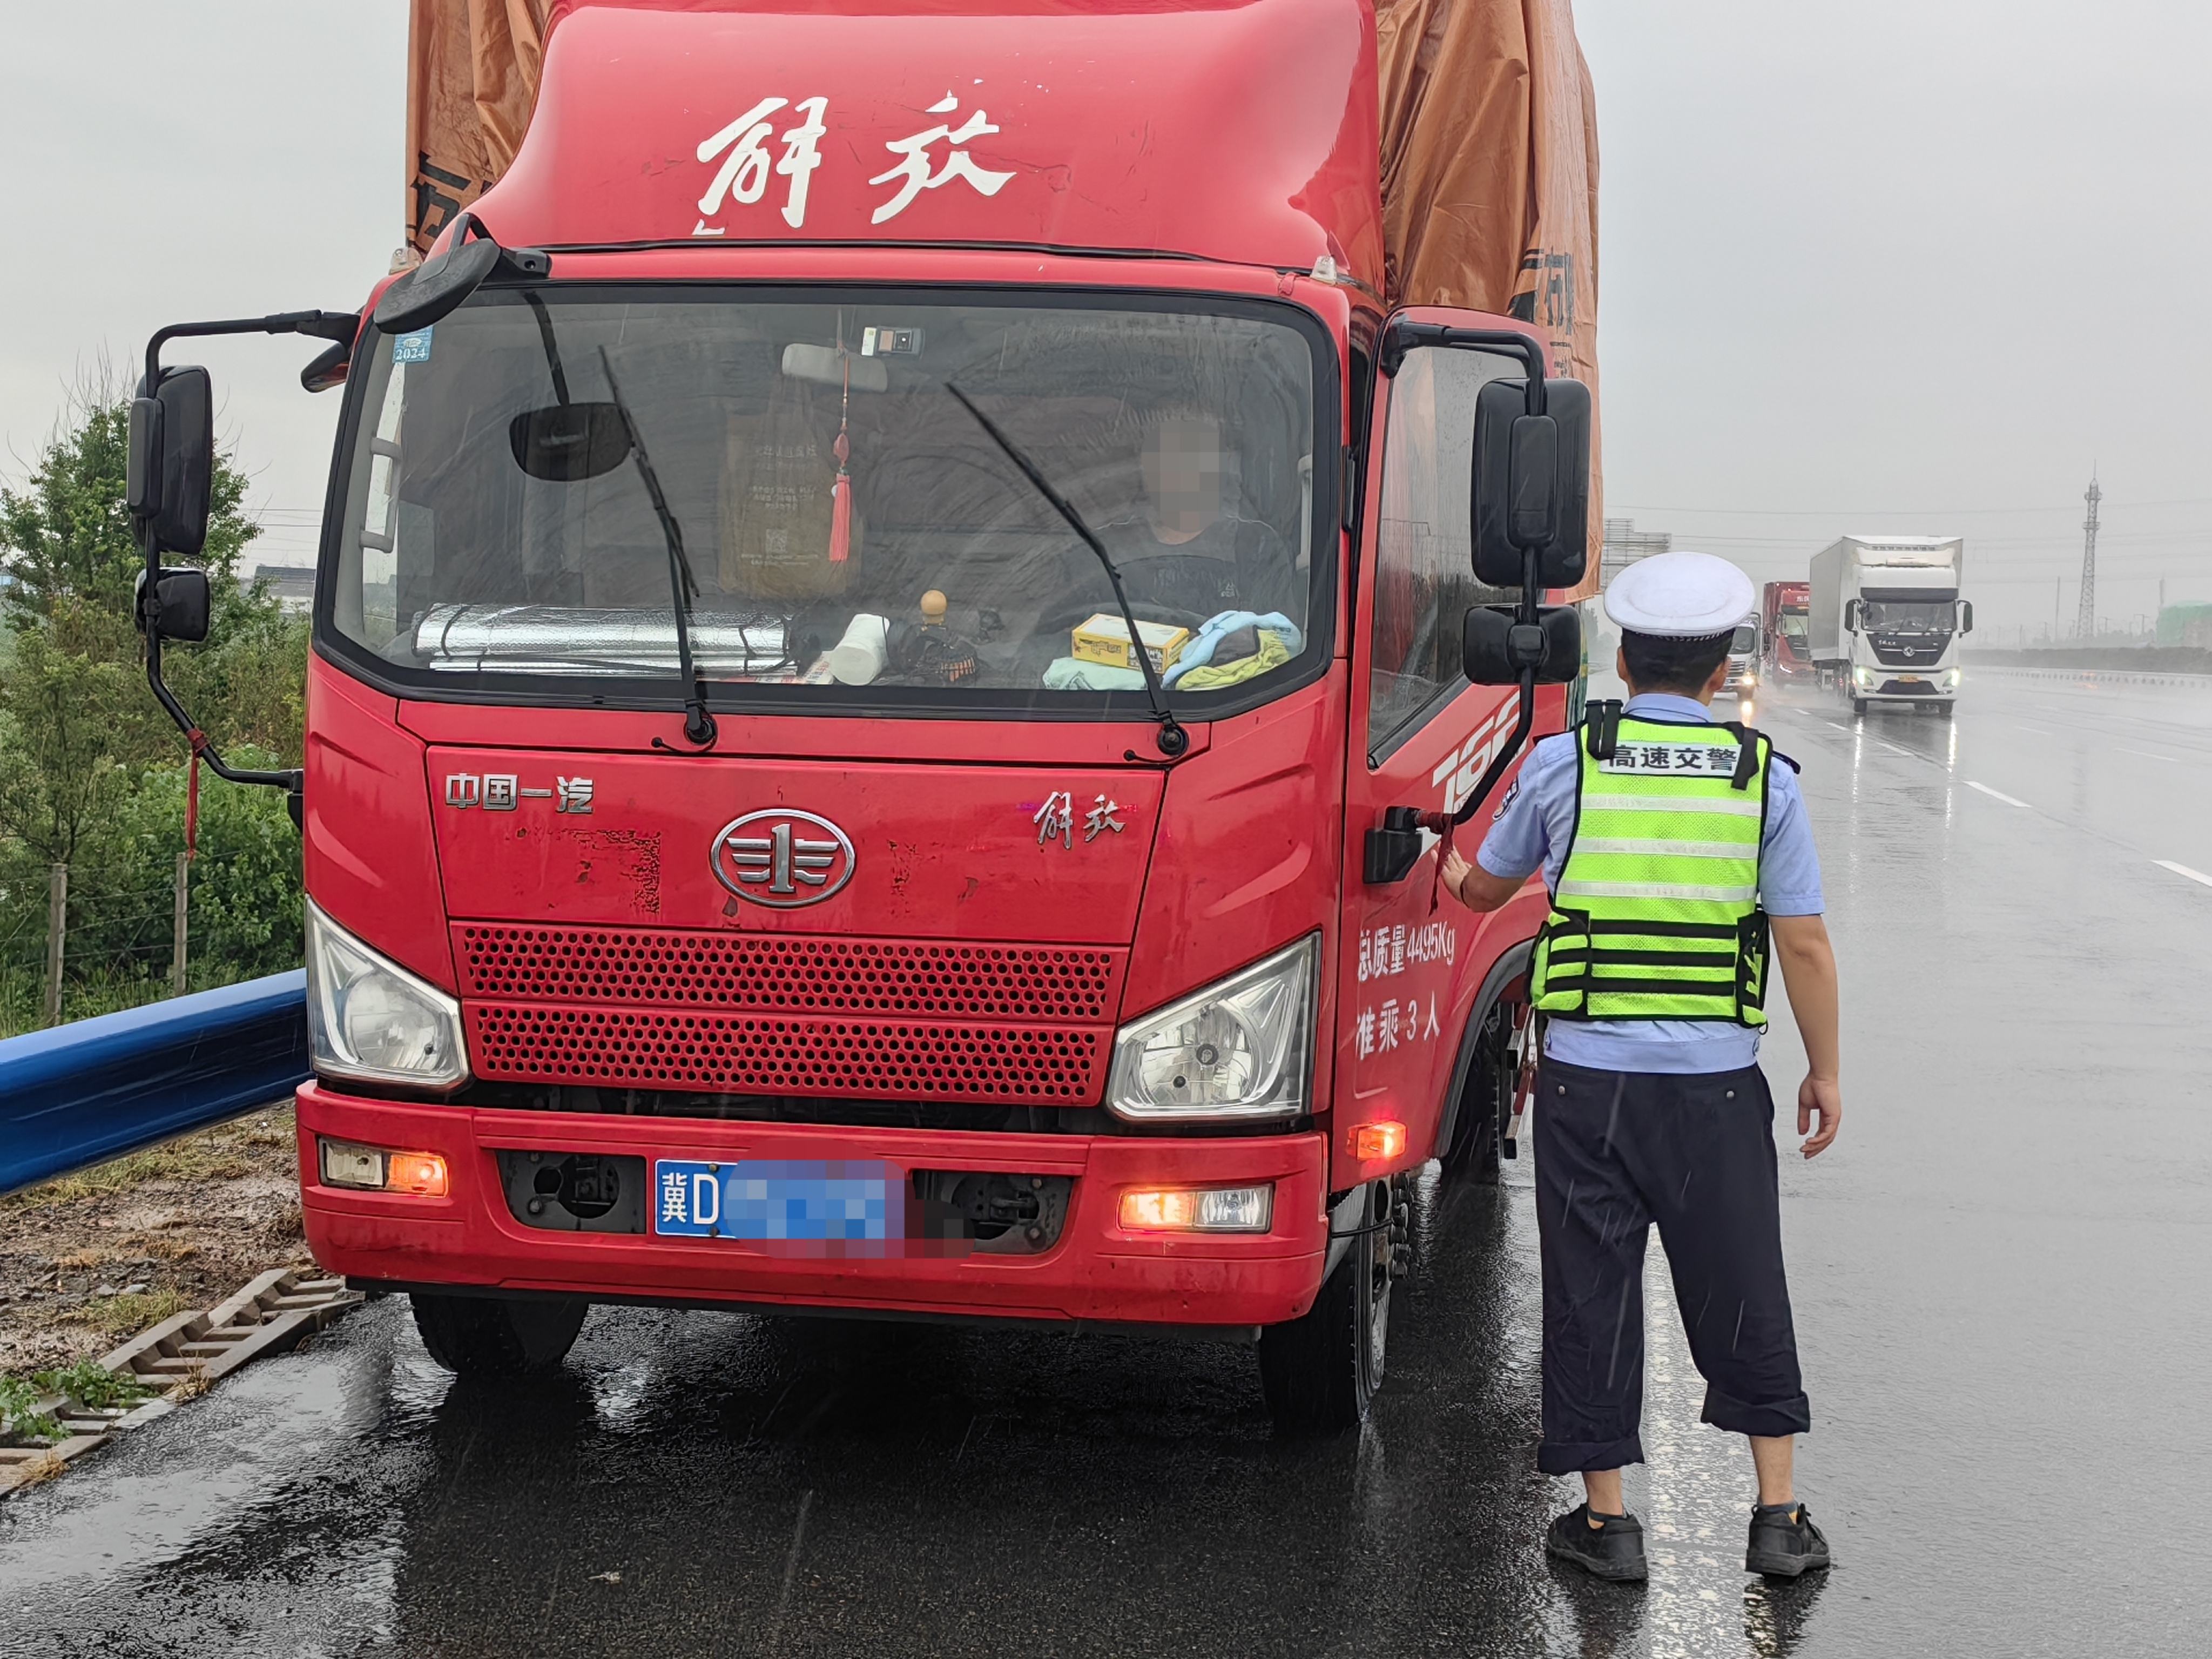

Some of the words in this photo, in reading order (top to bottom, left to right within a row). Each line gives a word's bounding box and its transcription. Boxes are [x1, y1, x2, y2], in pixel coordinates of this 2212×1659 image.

[696, 92, 1018, 228] 解放
[1609, 745, 1737, 771] 高速交警
[445, 772, 595, 814] 中国一汽
[1034, 791, 1125, 849] 解放
